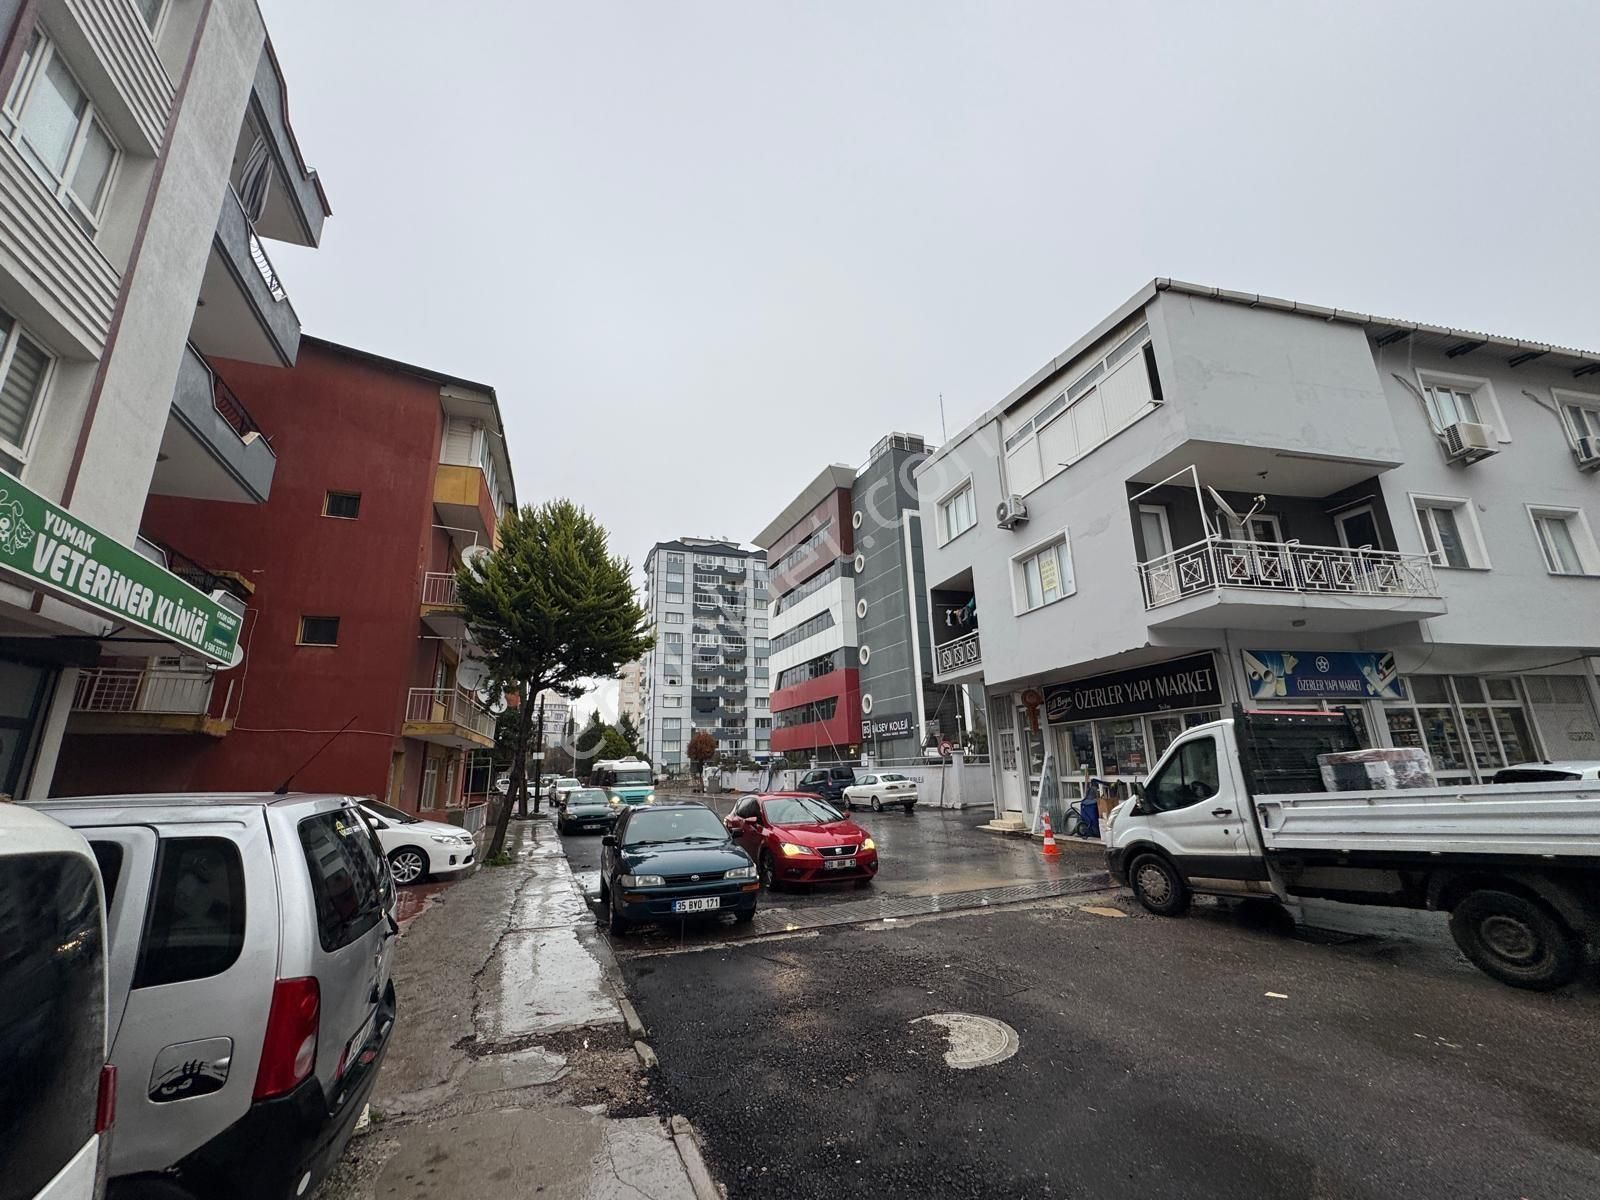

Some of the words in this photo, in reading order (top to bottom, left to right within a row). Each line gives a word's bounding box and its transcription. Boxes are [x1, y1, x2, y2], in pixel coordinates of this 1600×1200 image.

[44, 510, 96, 554] YUMAK
[32, 532, 154, 621] VETERİNER
[152, 595, 209, 645] KLİNİĞİ
[1074, 685, 1128, 710] ÖZERLER
[1124, 680, 1153, 702] YAPI
[1155, 669, 1213, 697] MARKET
[1297, 677, 1324, 691] ÖZERLER
[1324, 679, 1339, 691] YAPI
[1338, 679, 1362, 692] MARKET
[677, 901, 686, 910] 35
[706, 898, 718, 908] 171
